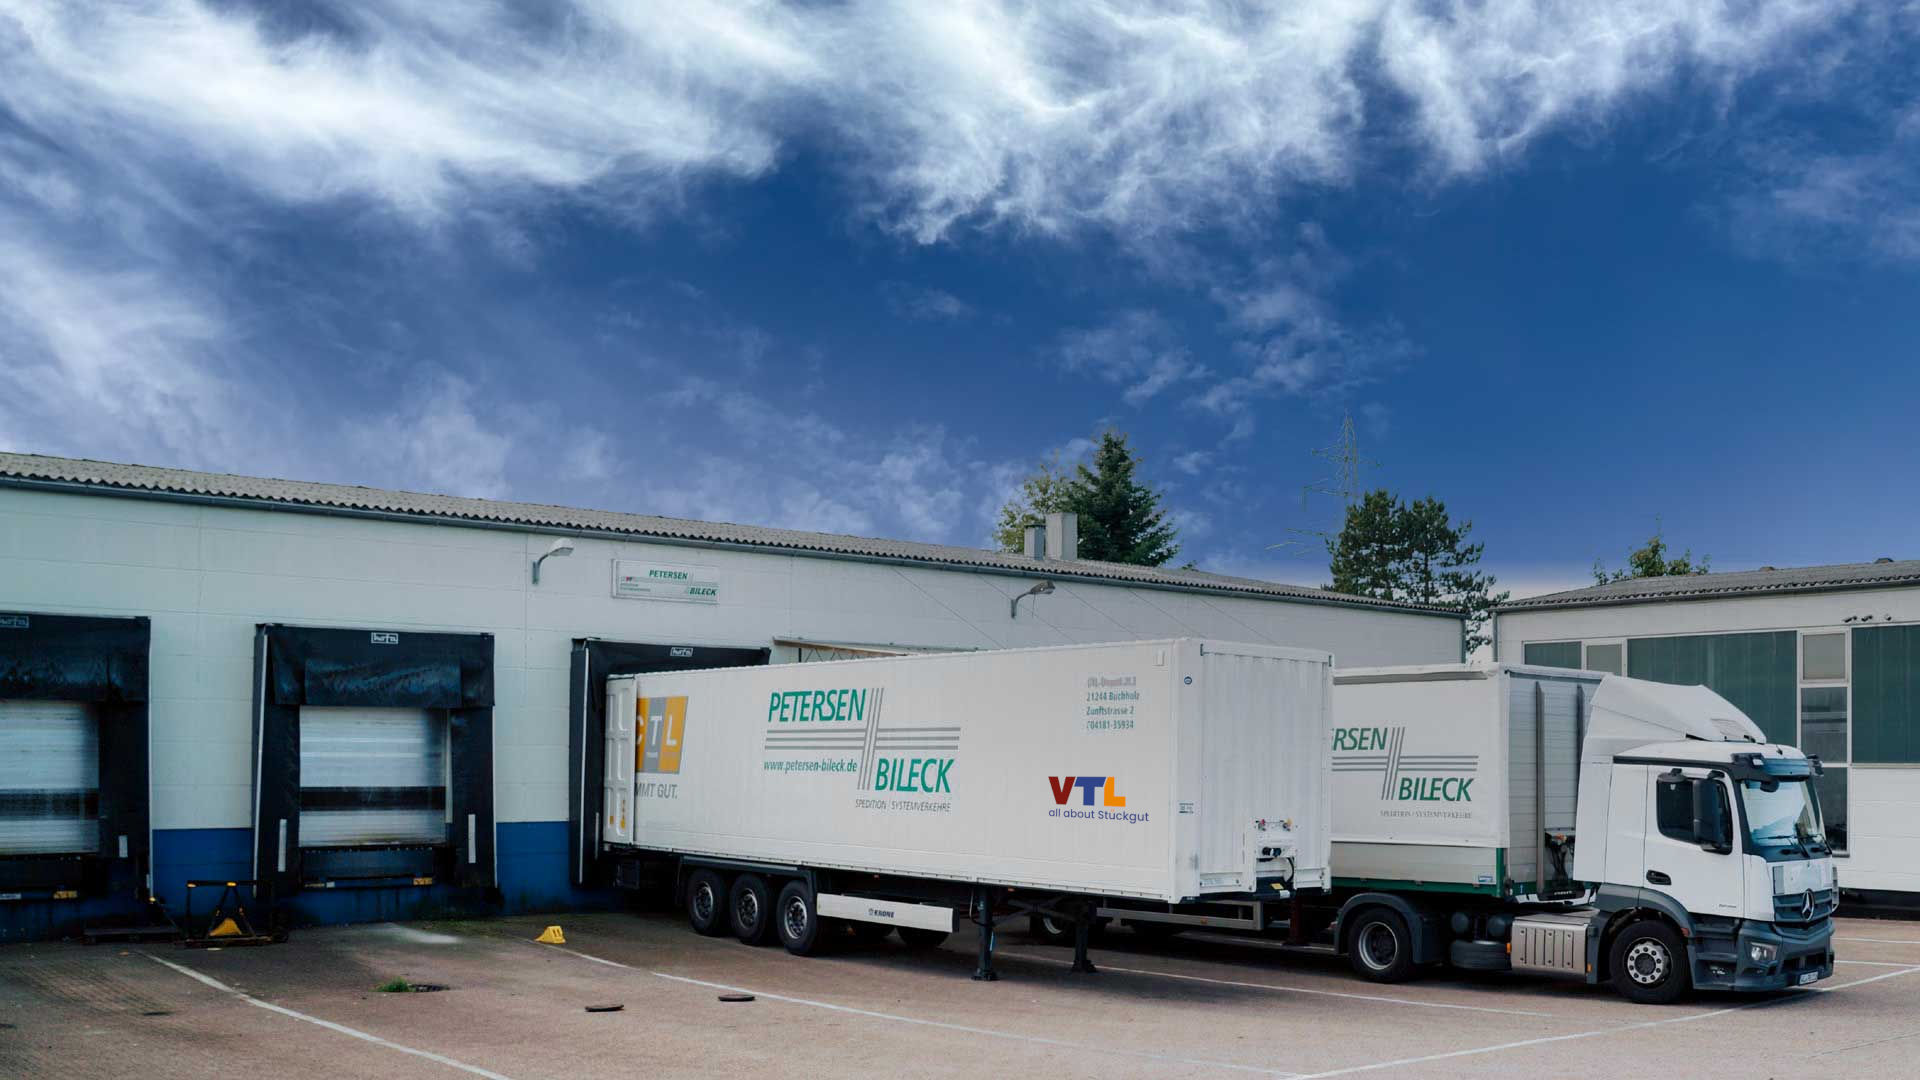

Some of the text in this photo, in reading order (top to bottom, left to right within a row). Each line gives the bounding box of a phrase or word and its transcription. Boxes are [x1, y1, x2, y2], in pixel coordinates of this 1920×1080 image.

[649, 570, 688, 580] PETERSEN
[689, 587, 717, 596] BILECK
[1086, 690, 1140, 702] 21244 Buchholz
[768, 688, 867, 723] PETERSEN
[1086, 705, 1135, 716] Zunftstrasse 2
[1331, 727, 1389, 751] RSEN
[763, 758, 858, 774] www.petersen-bileck.de
[874, 758, 955, 793] BILECK
[657, 783, 678, 799] GUT.
[1048, 776, 1127, 808] VTL
[1398, 777, 1475, 802] BILECK
[855, 799, 887, 810] SPEDITION
[891, 800, 951, 813] SYSTEMVERKEHRE
[1048, 808, 1150, 824] all about Stückgut
